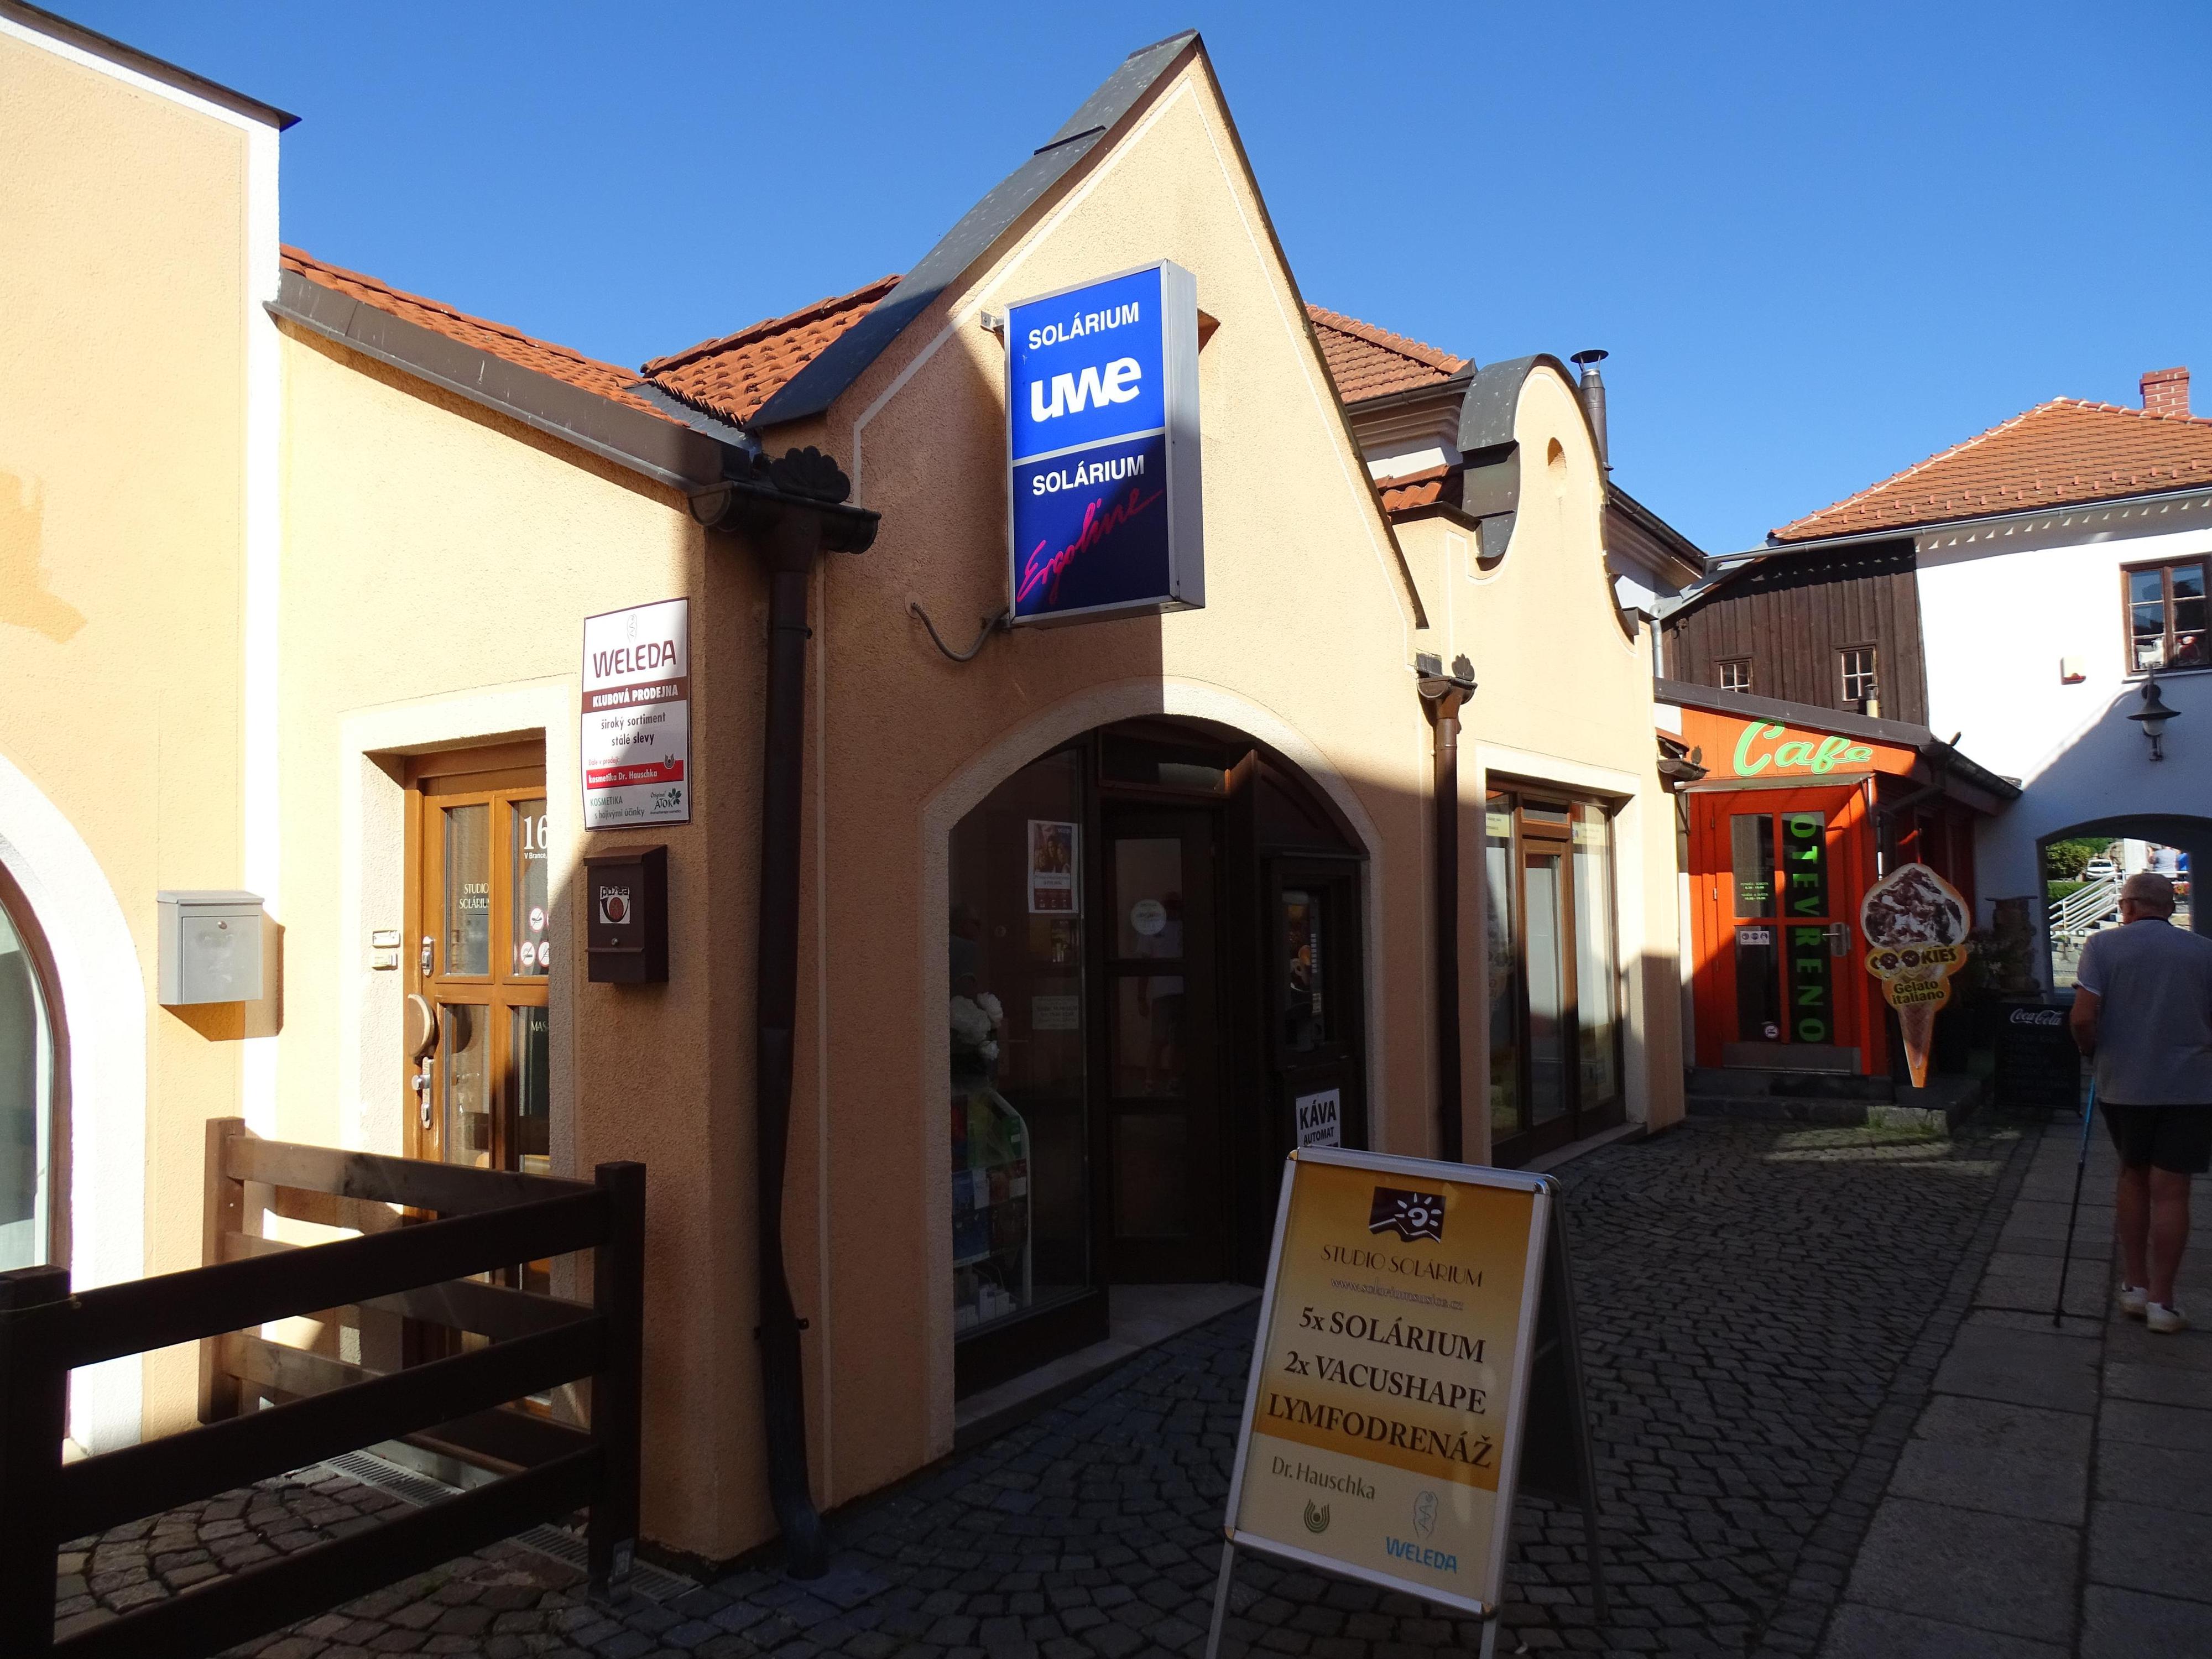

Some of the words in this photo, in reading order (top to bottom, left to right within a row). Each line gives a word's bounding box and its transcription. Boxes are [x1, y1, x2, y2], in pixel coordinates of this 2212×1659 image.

[1029, 301, 1139, 350] SOLÁRIUM
[1031, 357, 1142, 422] uwe
[1032, 455, 1145, 495] SOLÁRIUM
[1017, 488, 1162, 604] Ergoline
[593, 640, 676, 678] WELEDA
[592, 687, 630, 708] KLUBOVÁ
[632, 685, 679, 702] PRODEJNA
[601, 717, 624, 730] široký
[627, 712, 666, 726] sortiment
[612, 733, 630, 746] stálé
[633, 732, 655, 745] slevy
[588, 773, 617, 784] kosmetika
[618, 772, 627, 780] Dr.
[629, 769, 658, 779] Hauschka
[590, 796, 623, 806] KOSMETIKA
[654, 797, 674, 810] ATOK
[524, 815, 547, 849] 16
[459, 895, 490, 909] SOLÁRIU
[464, 883, 489, 894] STUDIO
[1892, 990, 1945, 1005] italiano
[1893, 980, 1938, 994] Gelato
[1300, 1099, 1337, 1130] KÁVA
[1303, 1127, 1334, 1145] AUTOMAT
[1321, 1244, 1385, 1270] STUDIO
[1388, 1252, 1483, 1287] SOLÁRIUM
[1298, 1307, 1325, 1331] 5x
[1329, 1311, 1486, 1363] SOLÁRIUM
[1284, 1351, 1311, 1375] 2x
[1316, 1354, 1486, 1414] VACUSHAPE
[1267, 1393, 1493, 1468] LYMFODRENÁŽ
[1272, 1455, 1293, 1479] Dr.
[1297, 1462, 1375, 1500] Hauschka
[1385, 1536, 1458, 1574] WELEDA
